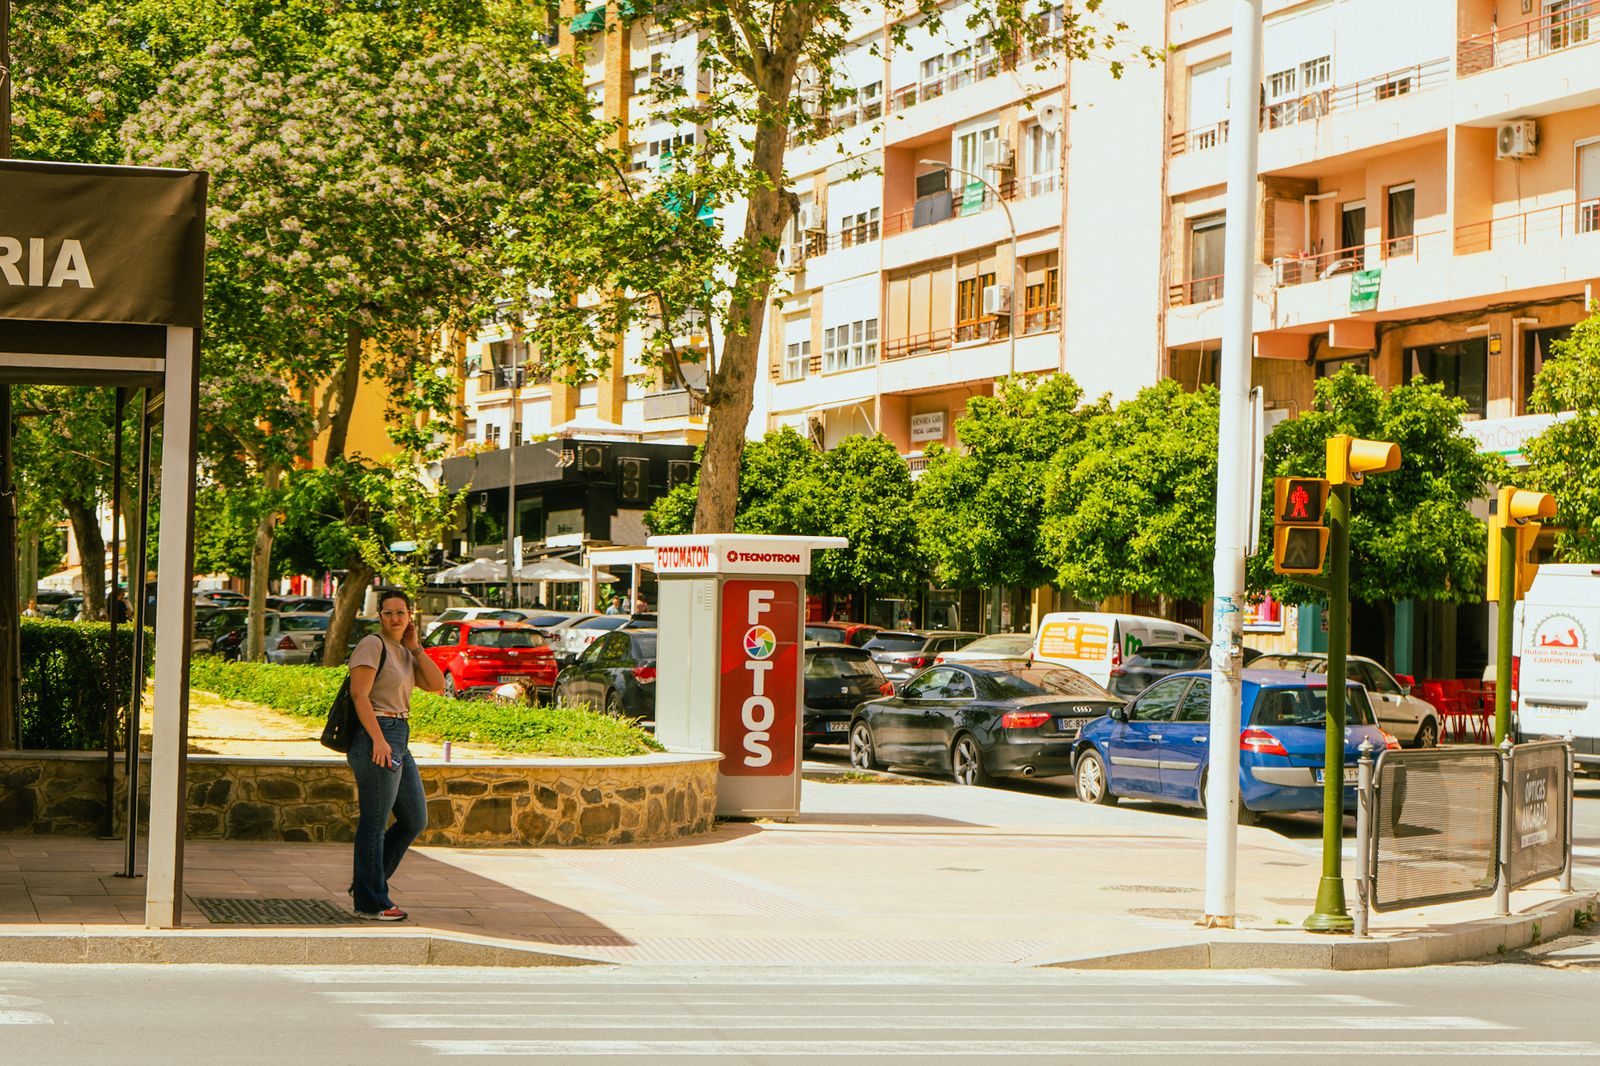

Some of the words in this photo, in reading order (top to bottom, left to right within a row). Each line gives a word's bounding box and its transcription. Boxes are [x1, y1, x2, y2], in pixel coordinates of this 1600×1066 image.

[0, 236, 95, 289] RIA
[657, 546, 710, 568] FOTOMATON
[739, 552, 800, 564] TECNOTRON
[741, 589, 776, 768] FOTOS
